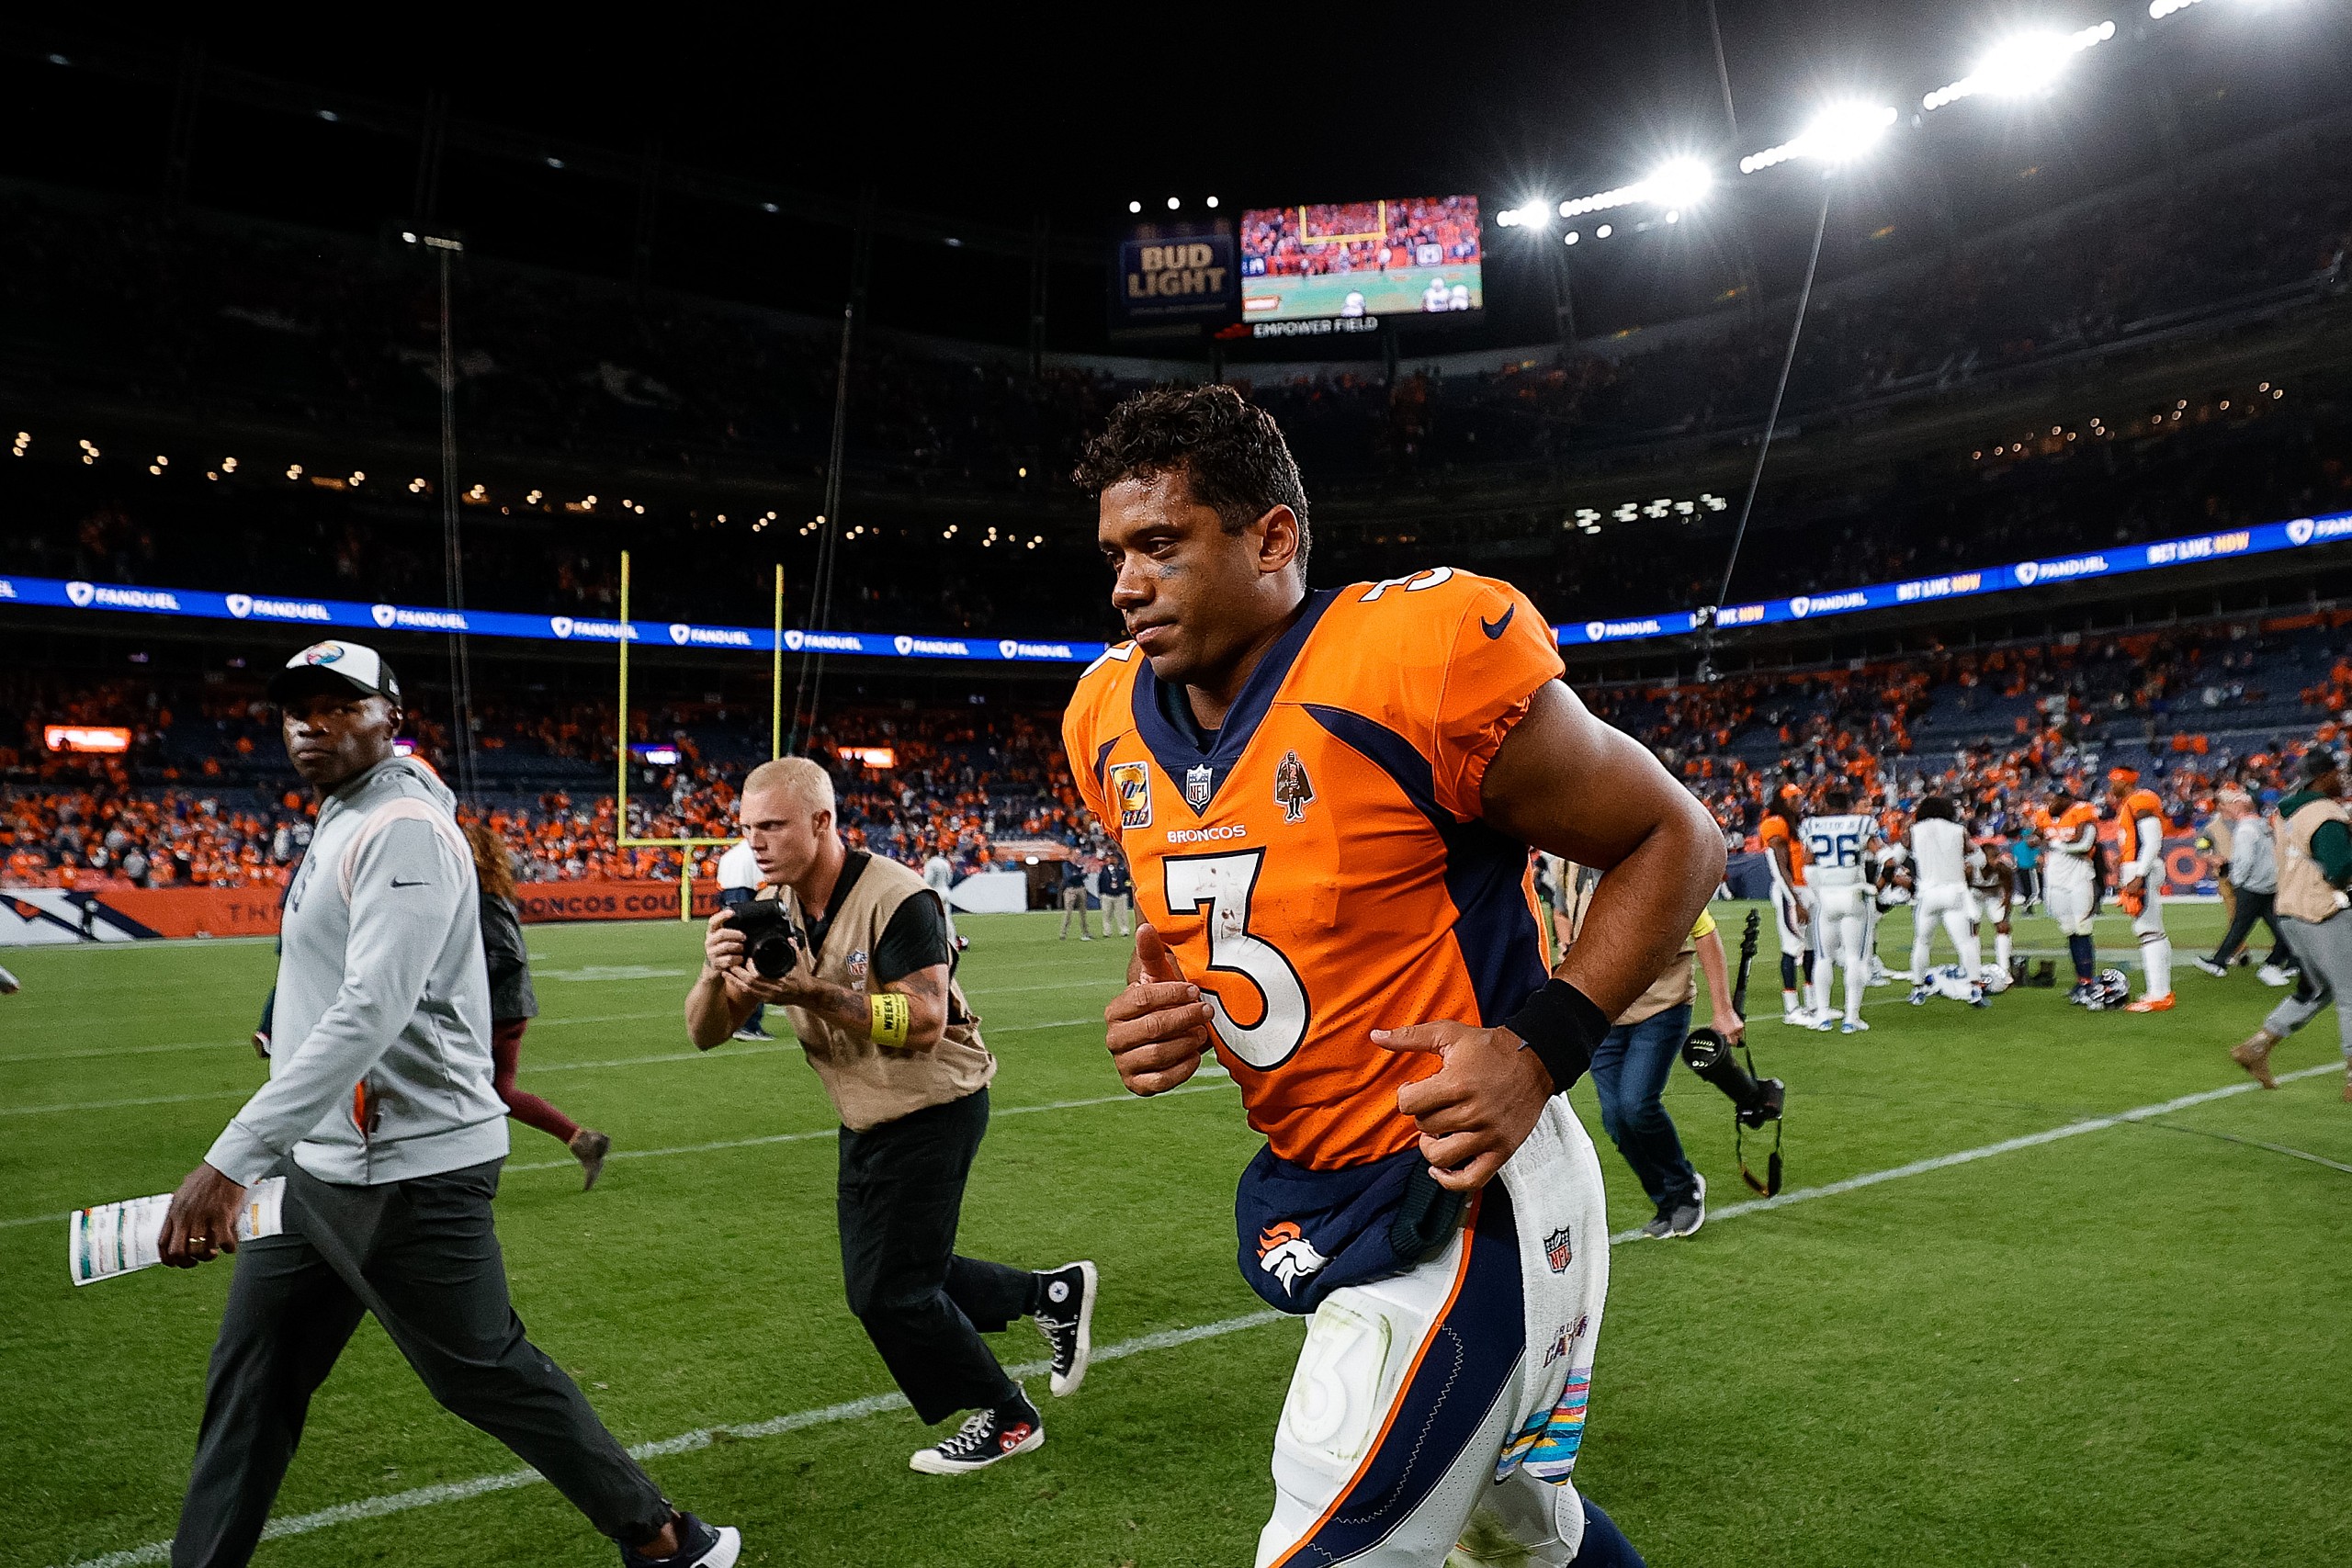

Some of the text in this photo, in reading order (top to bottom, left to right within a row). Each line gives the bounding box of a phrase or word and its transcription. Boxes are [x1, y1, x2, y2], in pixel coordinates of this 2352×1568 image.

[1140, 243, 1214, 272] BUD
[1128, 267, 1227, 299] LIGHT
[1253, 317, 1378, 338] EMPOWER FIELD
[2147, 531, 2250, 565] BET LIVE NOW
[2038, 556, 2109, 579] FANDUEL
[1896, 573, 1981, 602] BET LIVE NOW
[96, 588, 180, 611] FANDUEL
[253, 599, 332, 620] FANDUEL
[1810, 592, 1869, 613] FANDUEL
[397, 610, 469, 629] FANDUEL
[1605, 619, 1661, 637] FANDUEL
[691, 628, 752, 646] FANDUEL
[804, 634, 863, 651] FANDUEL
[912, 639, 969, 656] FANDUEL
[1017, 644, 1072, 659] FANDUEL
[1189, 784, 1210, 802] NFL
[1167, 825, 1247, 844] BRONCOS
[1811, 834, 1861, 867] 26
[229, 903, 283, 921] TH
[1162, 845, 1311, 1072] 3
[883, 1000, 894, 1031] WEEK
[1289, 1307, 1370, 1445] 3
